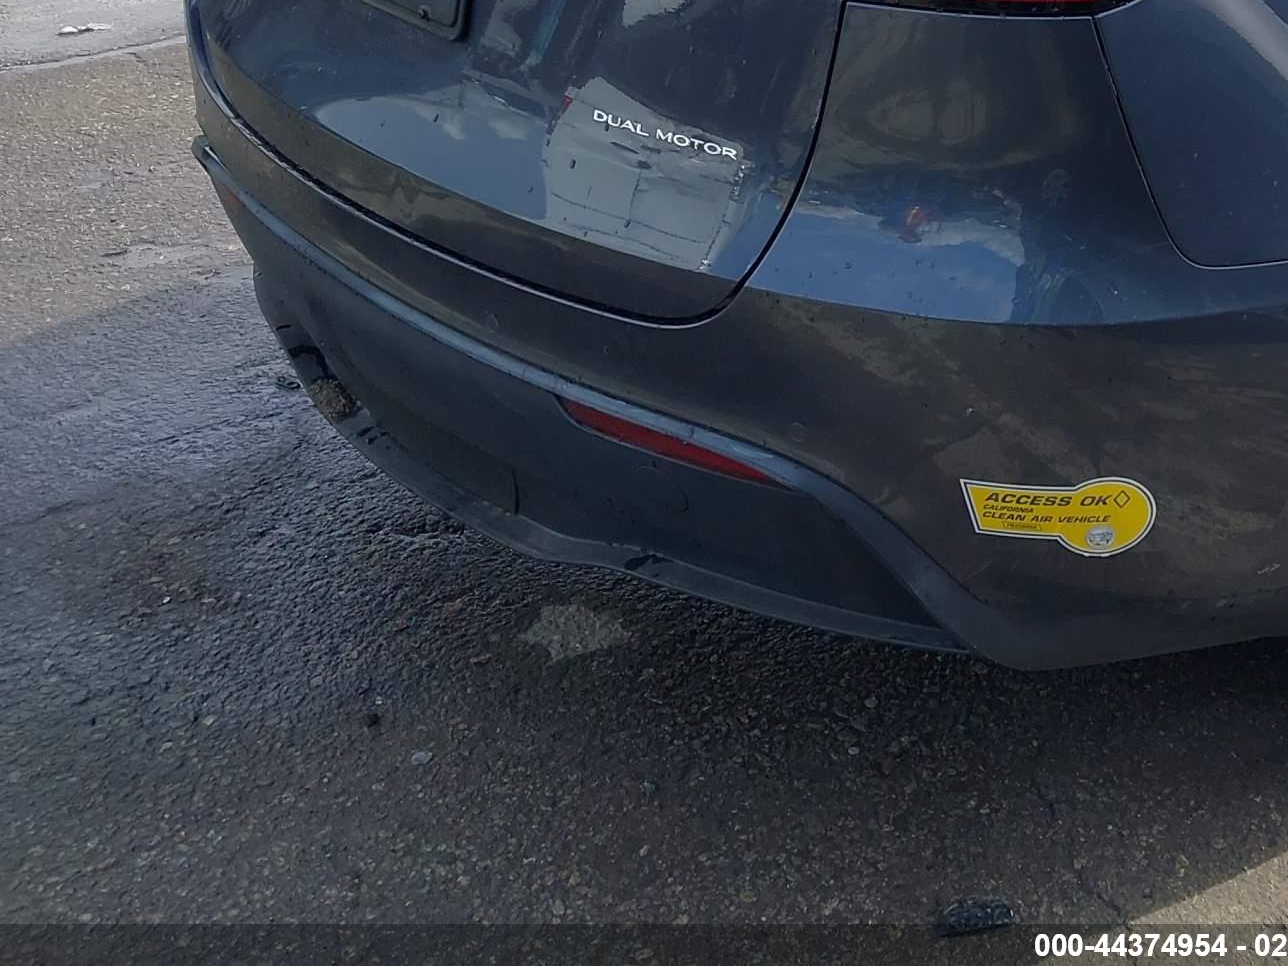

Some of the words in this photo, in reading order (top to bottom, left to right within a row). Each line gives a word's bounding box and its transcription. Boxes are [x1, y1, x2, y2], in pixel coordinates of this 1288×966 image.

[593, 109, 650, 137] DUAL
[656, 128, 738, 161] MOTOR
[985, 492, 1073, 507] ACCESS
[1080, 495, 1112, 507] OK
[983, 504, 1034, 514] CALIFORNIA
[982, 511, 1026, 522] CLEAN
[1030, 515, 1053, 523] AIR
[1058, 514, 1111, 523] VEHICLE
